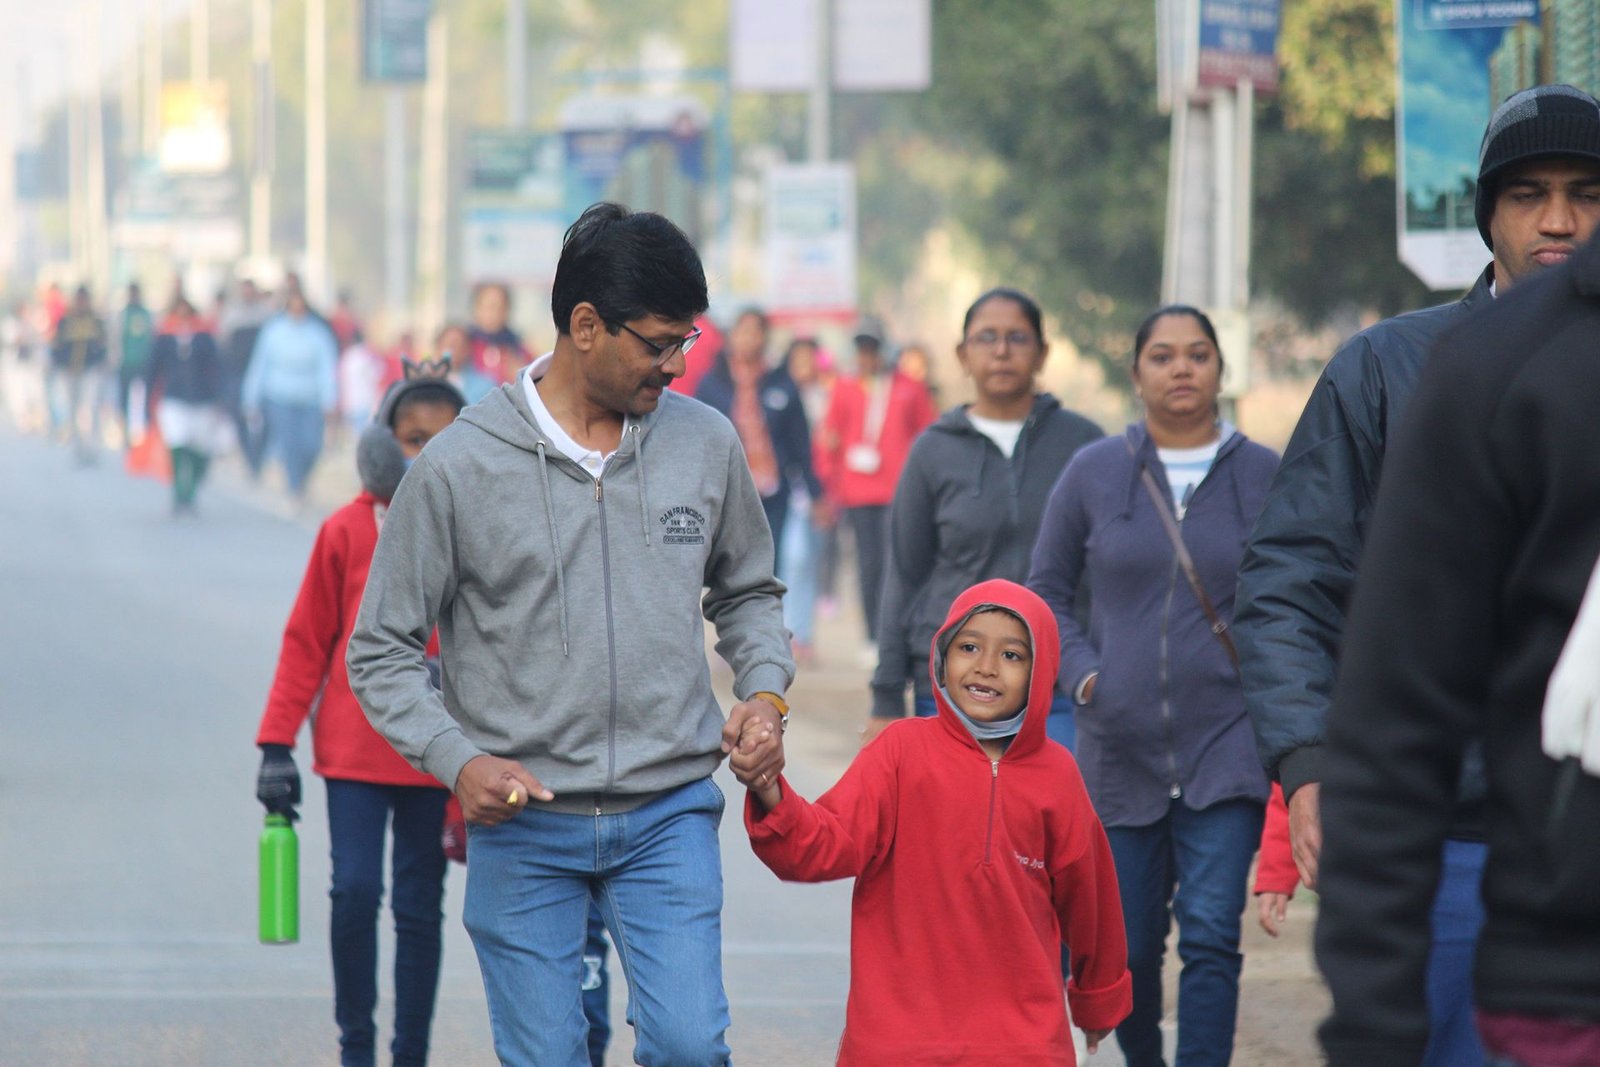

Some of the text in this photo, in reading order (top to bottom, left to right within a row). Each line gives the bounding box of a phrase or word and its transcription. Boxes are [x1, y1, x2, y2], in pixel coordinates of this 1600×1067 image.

[660, 509, 673, 525] SAN
[672, 506, 705, 525] FRANCISCO
[686, 527, 700, 535] CLUB
